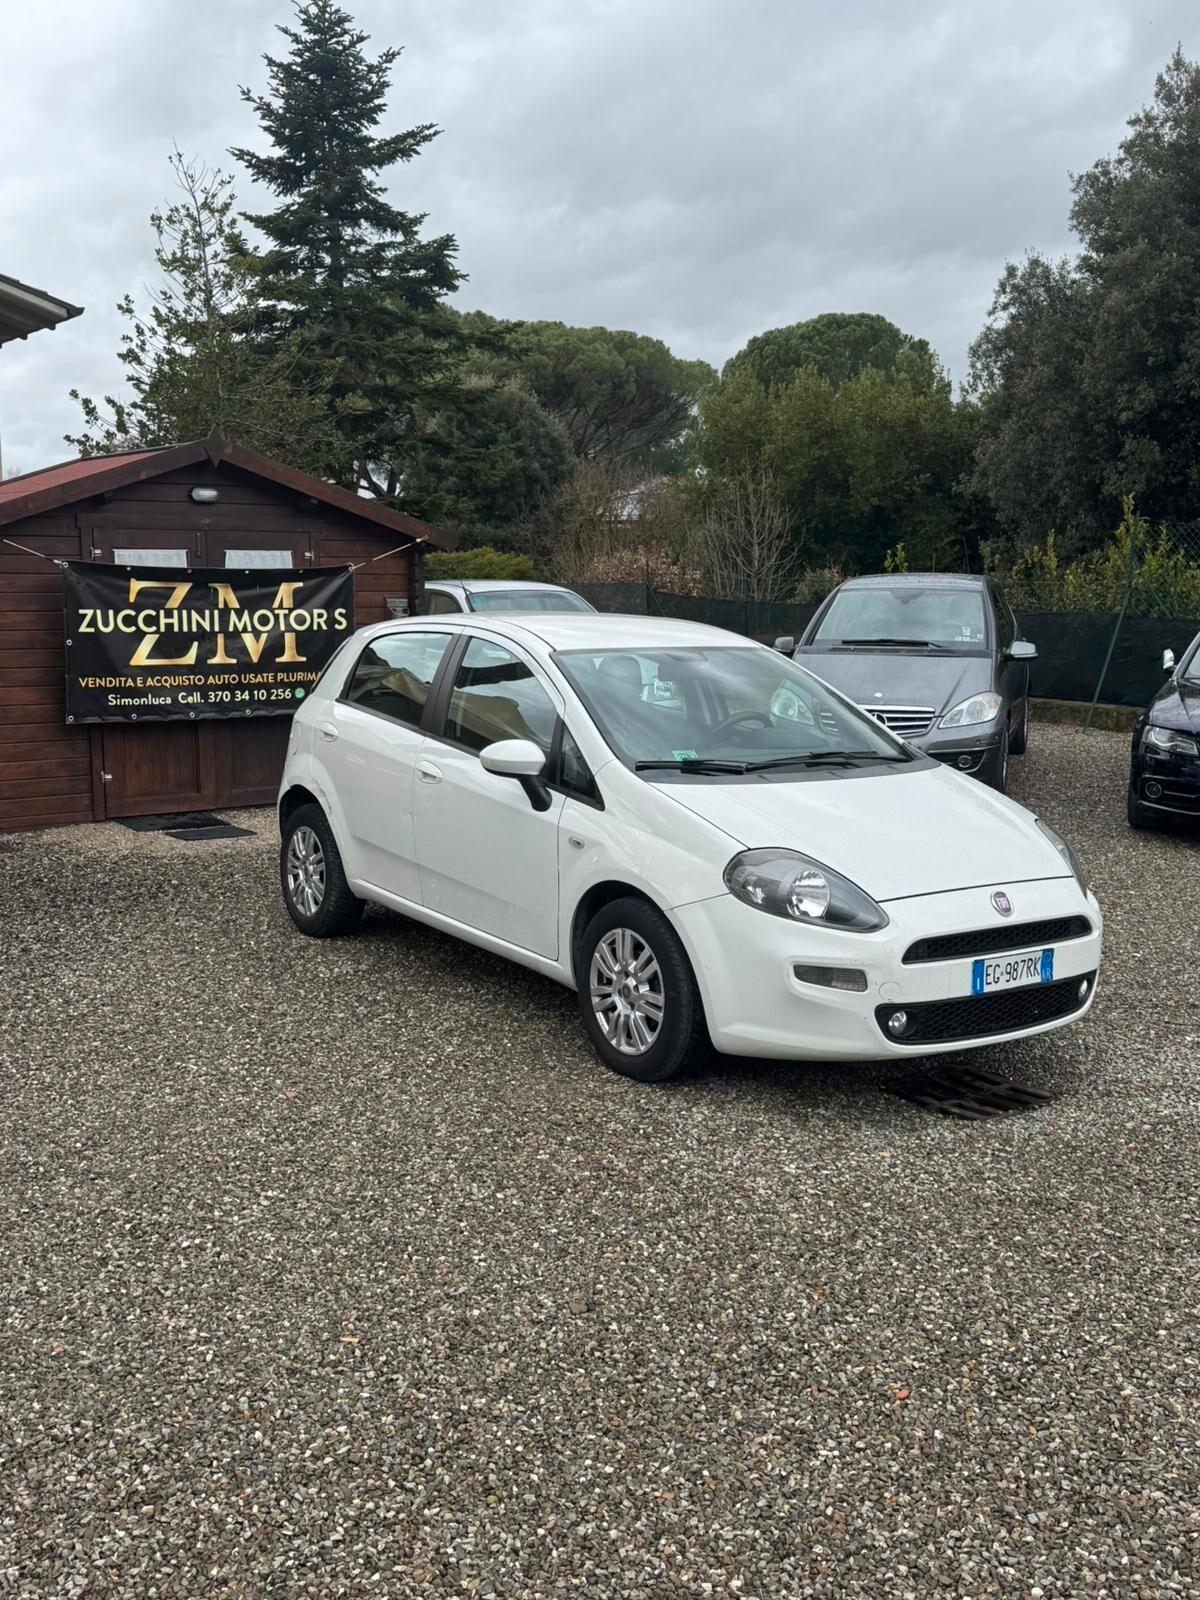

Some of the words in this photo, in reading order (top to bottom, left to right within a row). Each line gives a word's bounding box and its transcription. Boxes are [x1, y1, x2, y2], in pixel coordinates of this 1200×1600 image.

[78, 608, 220, 633] ZUCCHINI
[129, 578, 307, 665] ZM
[79, 677, 135, 688] VENDITA
[136, 676, 144, 687] E
[146, 675, 205, 688] ACQUISTO
[207, 674, 239, 685] AUTO
[241, 672, 275, 683] USATE
[108, 693, 172, 706] Simonluca
[178, 691, 205, 704] Cell.
[207, 691, 231, 703] 370
[234, 690, 250, 702] 34
[253, 690, 267, 701] 10
[270, 688, 292, 700] 256
